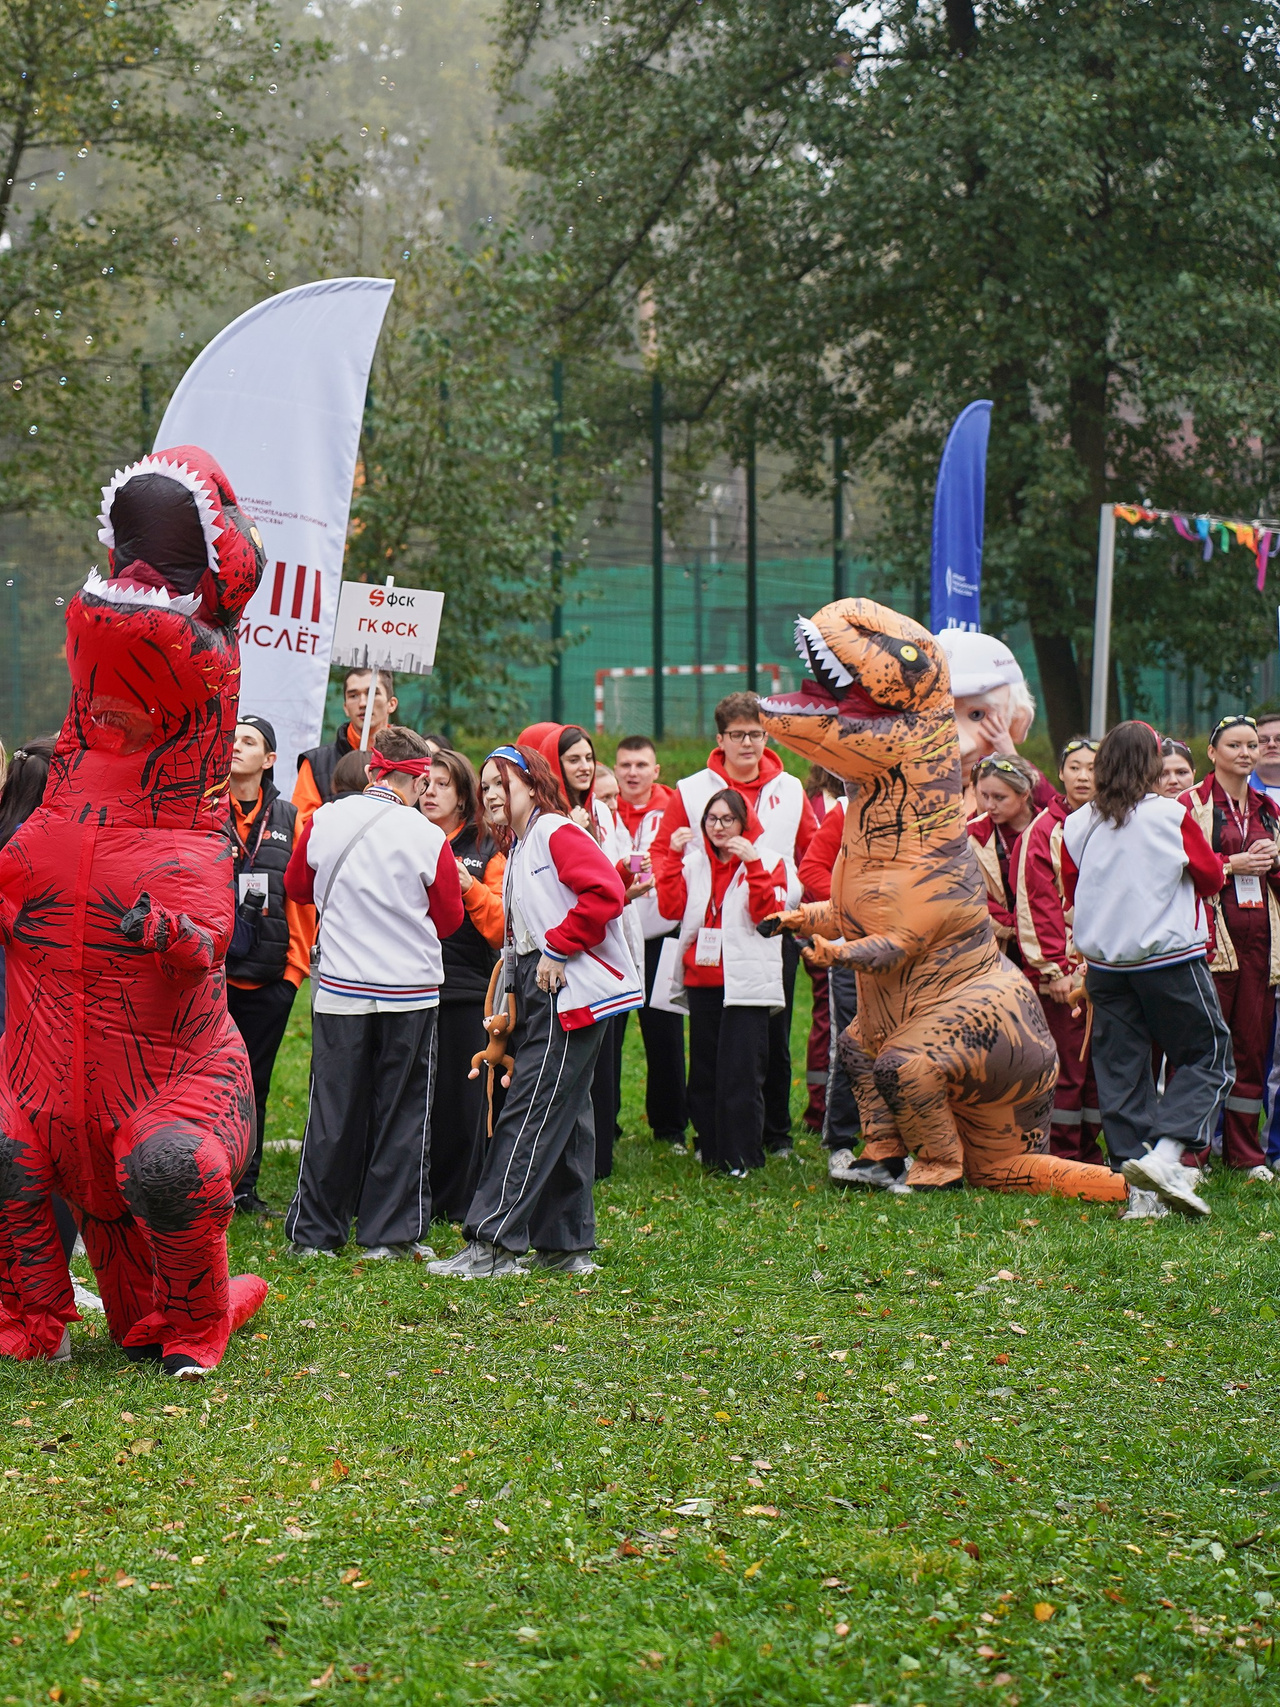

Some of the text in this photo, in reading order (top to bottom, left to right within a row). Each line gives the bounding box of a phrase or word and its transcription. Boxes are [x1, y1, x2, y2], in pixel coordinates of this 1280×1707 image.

[386, 592, 416, 608] ФСК
[358, 617, 419, 638] ГК ФСК
[463, 857, 483, 869] ФСК
